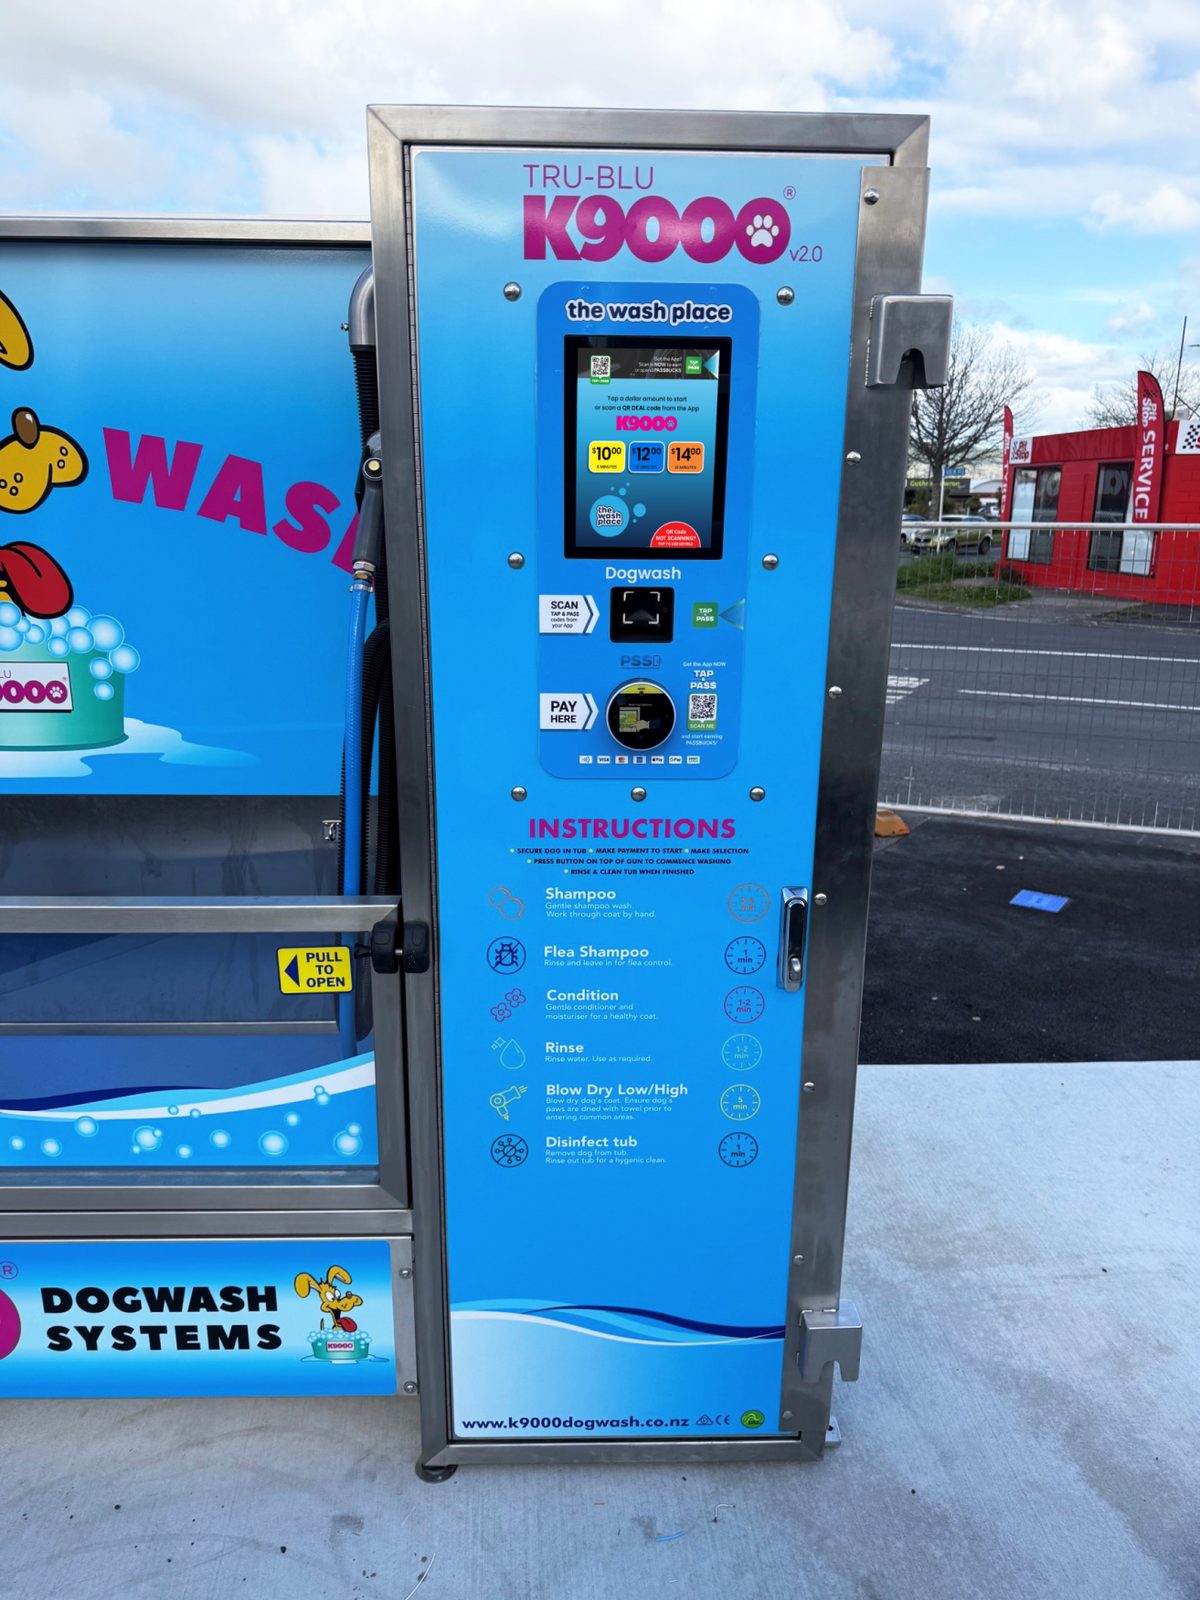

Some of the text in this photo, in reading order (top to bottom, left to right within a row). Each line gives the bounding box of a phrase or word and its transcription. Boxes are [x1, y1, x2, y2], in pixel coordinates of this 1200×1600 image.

[523, 164, 654, 189] TRU-BLU
[523, 194, 791, 264] K9000
[789, 245, 823, 263] v2.0
[566, 301, 731, 325] the wash place
[1142, 397, 1150, 428] Stop
[1148, 402, 1157, 421] Pit
[616, 415, 678, 432] K9000
[1016, 449, 1029, 460] Stop
[1135, 430, 1156, 520] SERVICE
[103, 427, 359, 575] WAS
[598, 518, 621, 526] place
[605, 566, 681, 584] Dogwash
[551, 601, 578, 609] SCAN
[550, 701, 578, 712] PAY
[550, 715, 576, 723] HERE
[529, 818, 736, 838] INSTRUCTIONS
[546, 888, 616, 902] Shampoo
[574, 902, 610, 910] shampoo
[570, 911, 600, 919] through
[623, 911, 632, 919] by
[306, 952, 343, 962] PULL
[544, 946, 649, 960] Flea Shampoo
[315, 965, 334, 974] TO
[306, 977, 345, 987] OPEN
[547, 989, 619, 1001] Condition
[610, 1013, 637, 1021] healthy
[545, 1042, 584, 1053] Rinse
[546, 1084, 688, 1098] Blow Dry Low/High
[546, 1136, 637, 1147] Disinfect tub
[40, 1286, 278, 1313] DOGWASH
[47, 1324, 282, 1351] SYSTEMS
[462, 1416, 689, 1430] www.k9000dogwash.co.nz
